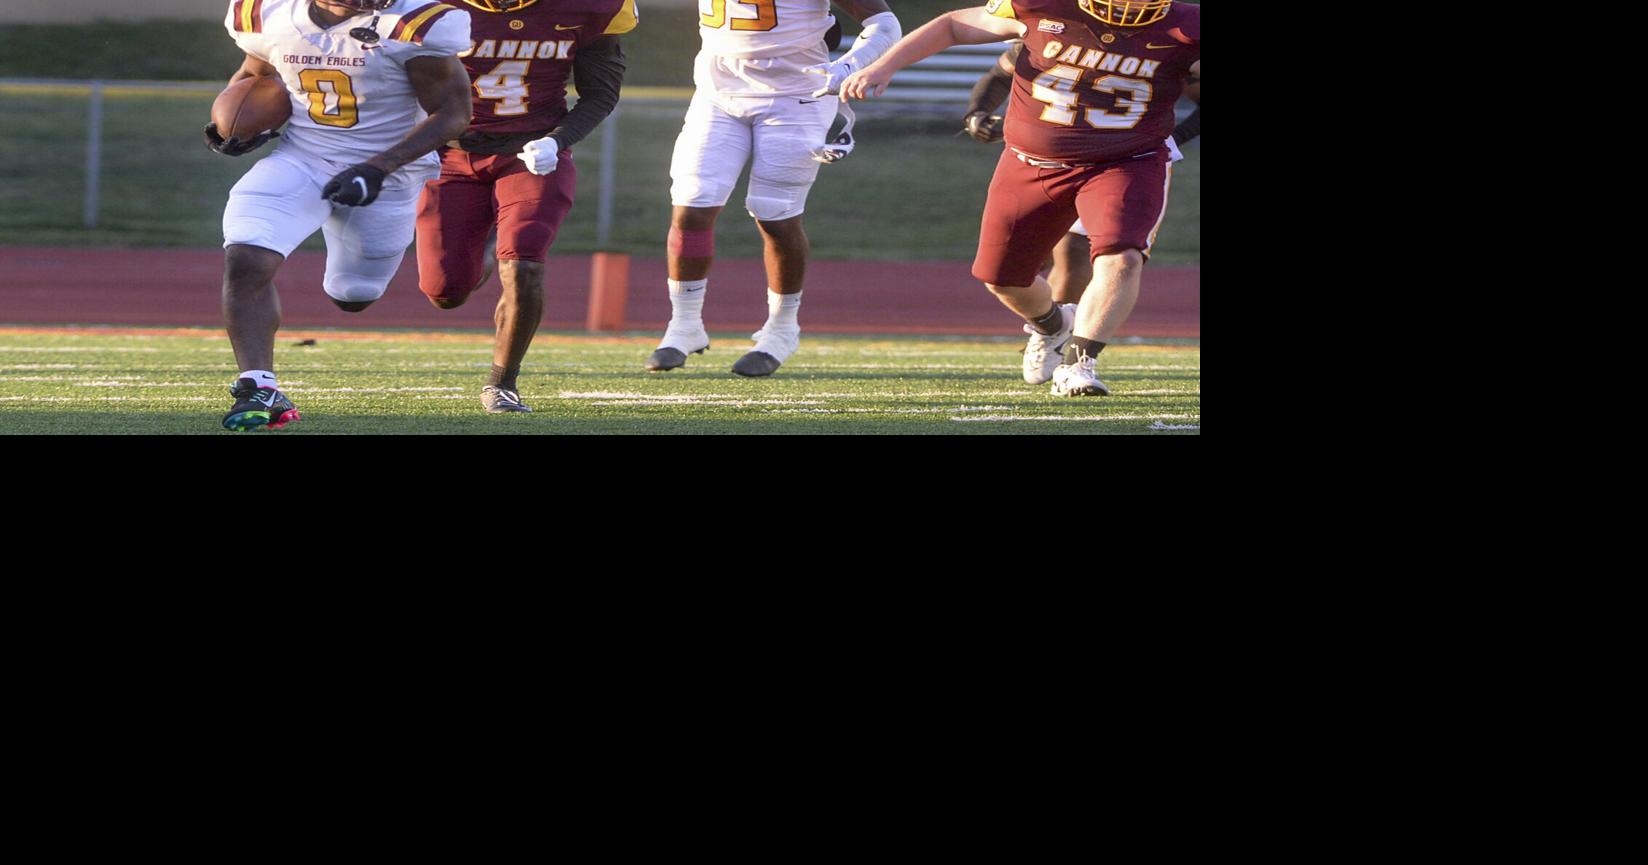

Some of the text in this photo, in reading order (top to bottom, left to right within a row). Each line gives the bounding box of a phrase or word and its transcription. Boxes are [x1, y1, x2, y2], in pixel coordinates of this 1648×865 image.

[283, 54, 366, 67] GOLDEN EAGLES
[473, 60, 531, 116] 4
[1032, 63, 1153, 129] 43
